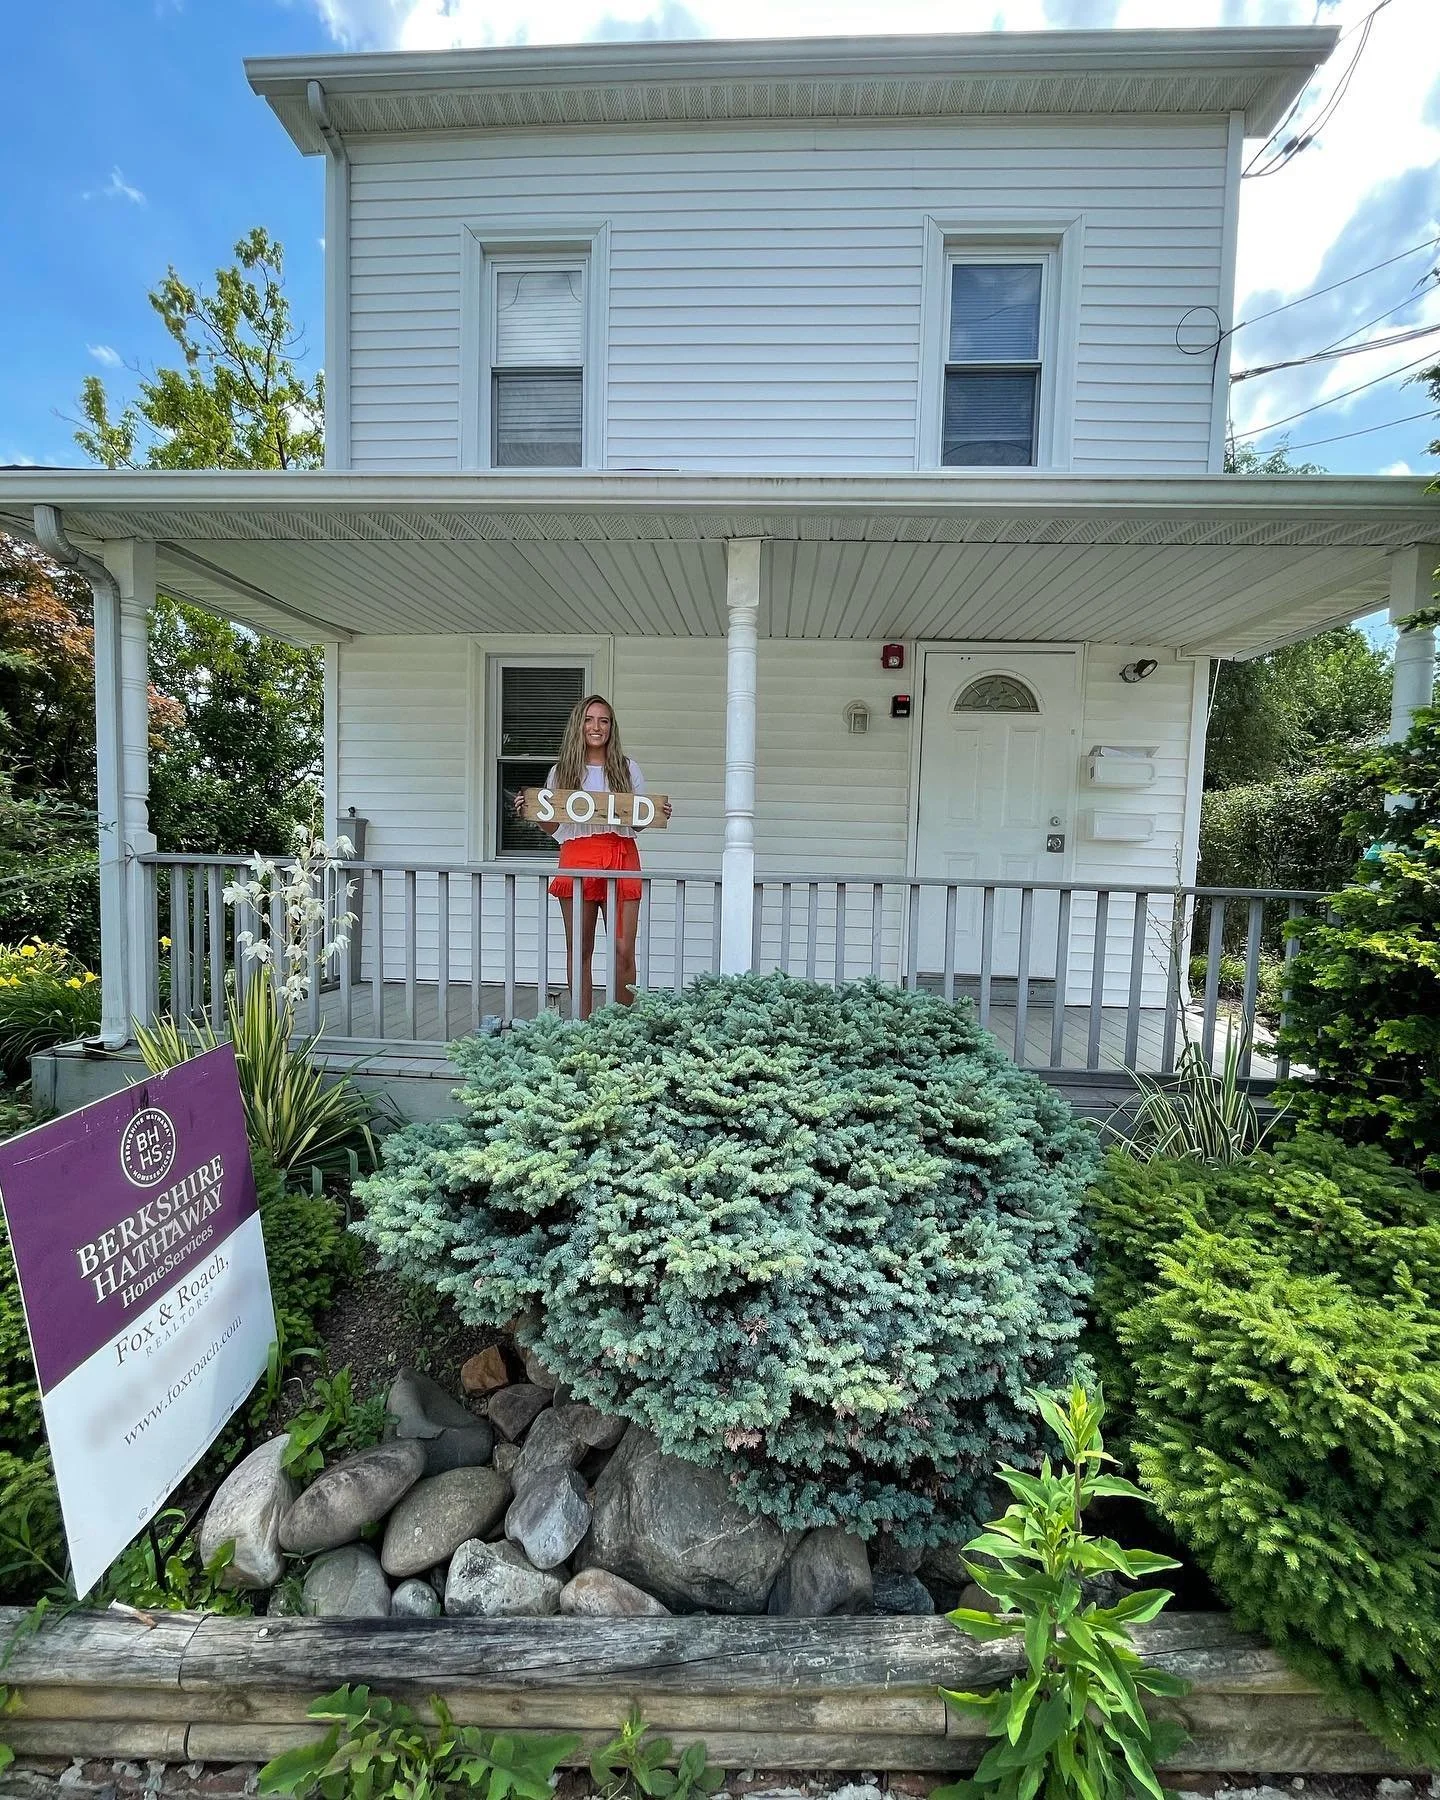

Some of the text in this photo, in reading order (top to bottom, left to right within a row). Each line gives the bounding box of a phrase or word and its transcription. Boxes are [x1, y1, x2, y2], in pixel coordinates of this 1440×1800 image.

[537, 789, 655, 826] SOLD
[136, 1125, 160, 1152] BH
[140, 1144, 162, 1170] HS
[77, 1155, 224, 1278] BERKSHIRE
[92, 1183, 223, 1303] HATHAWAY
[114, 1255, 229, 1367] Fox & Roach,
[121, 1224, 213, 1308] HomeServices
[124, 1315, 242, 1446] www.foxroach.com
